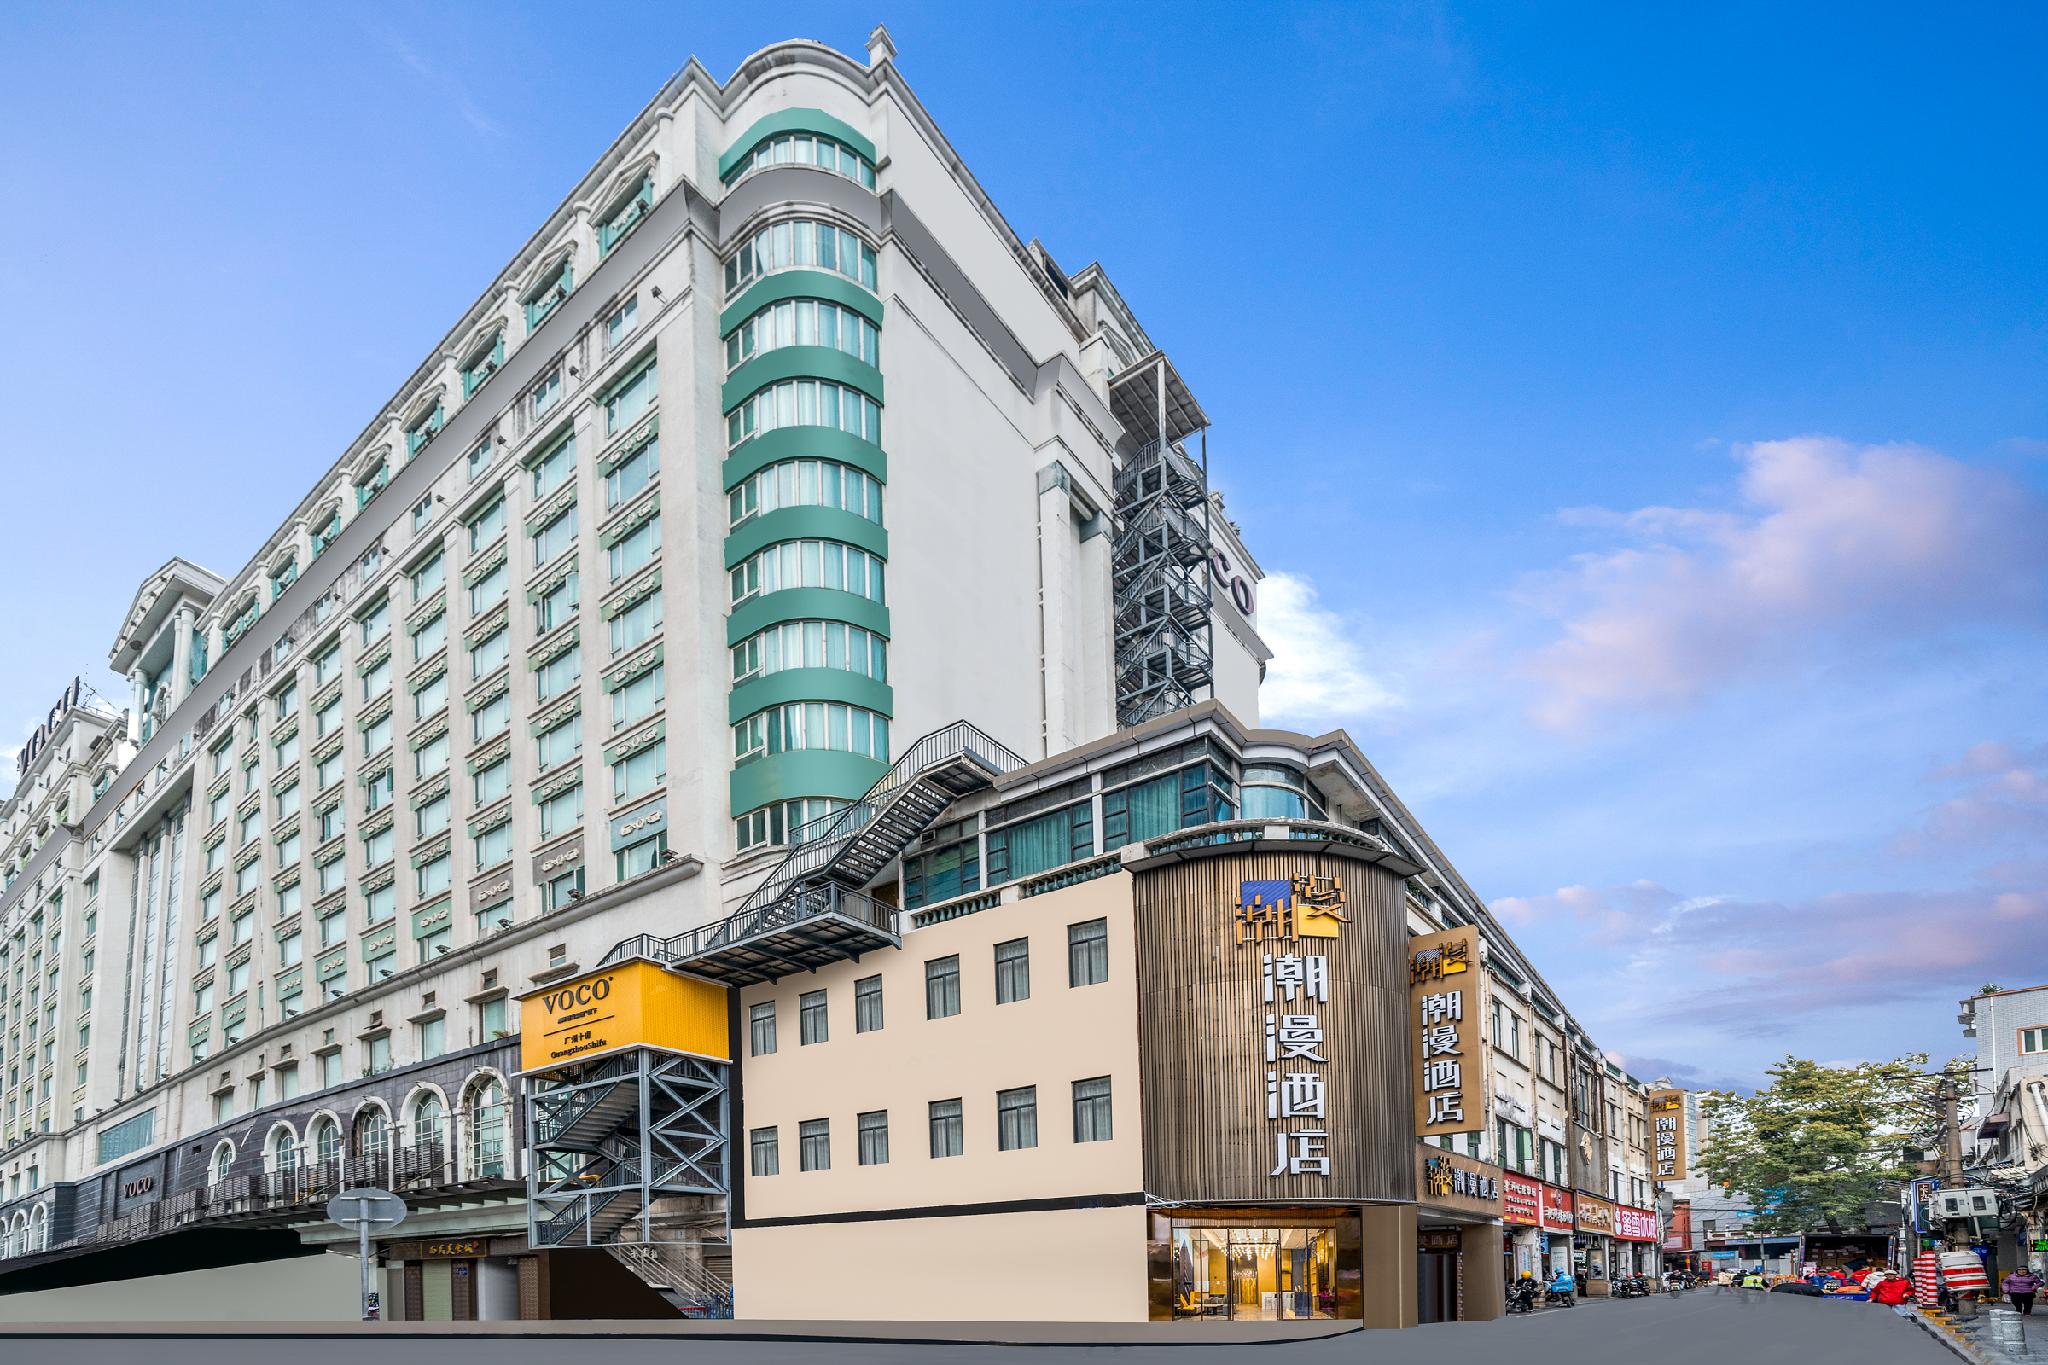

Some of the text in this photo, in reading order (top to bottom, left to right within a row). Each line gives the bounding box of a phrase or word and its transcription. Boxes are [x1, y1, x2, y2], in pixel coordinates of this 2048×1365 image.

[542, 978, 610, 1015] VOCO
[1263, 952, 1330, 1177] 潮漫酒店
[1421, 989, 1465, 1125] 潮漫酒店
[1655, 1117, 1678, 1177] 潮漫酒店
[124, 1176, 153, 1199] VOCO
[1453, 1167, 1499, 1200] 潮漫酒店
[1621, 1210, 1657, 1240] 蜜雪冰城
